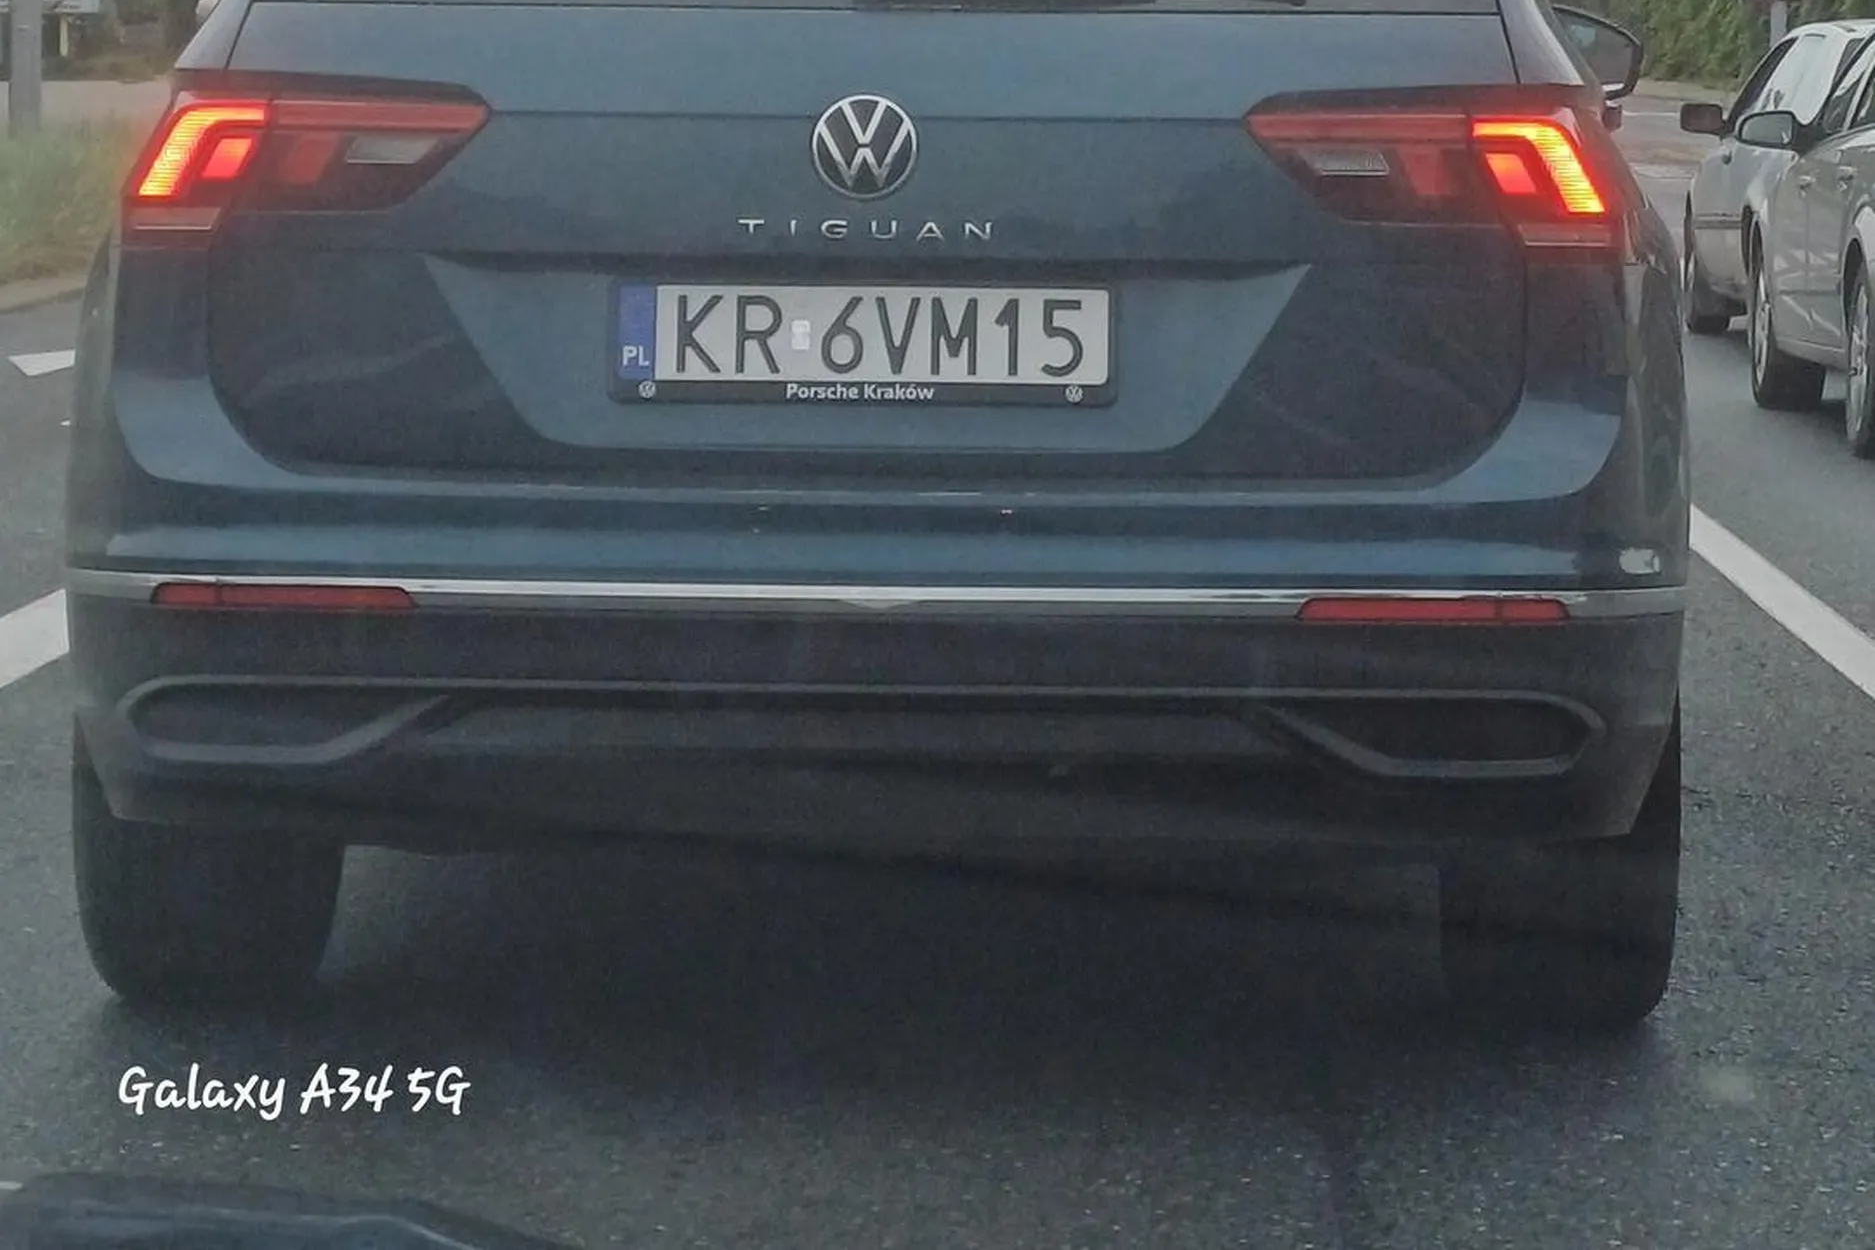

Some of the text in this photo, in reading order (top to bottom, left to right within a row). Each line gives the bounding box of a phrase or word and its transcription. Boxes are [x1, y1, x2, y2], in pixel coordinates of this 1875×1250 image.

[738, 218, 993, 241] TIGUAN
[675, 294, 1084, 378] KR 6VM15
[622, 346, 650, 367] PL
[786, 383, 935, 400] Porsche Kraków
